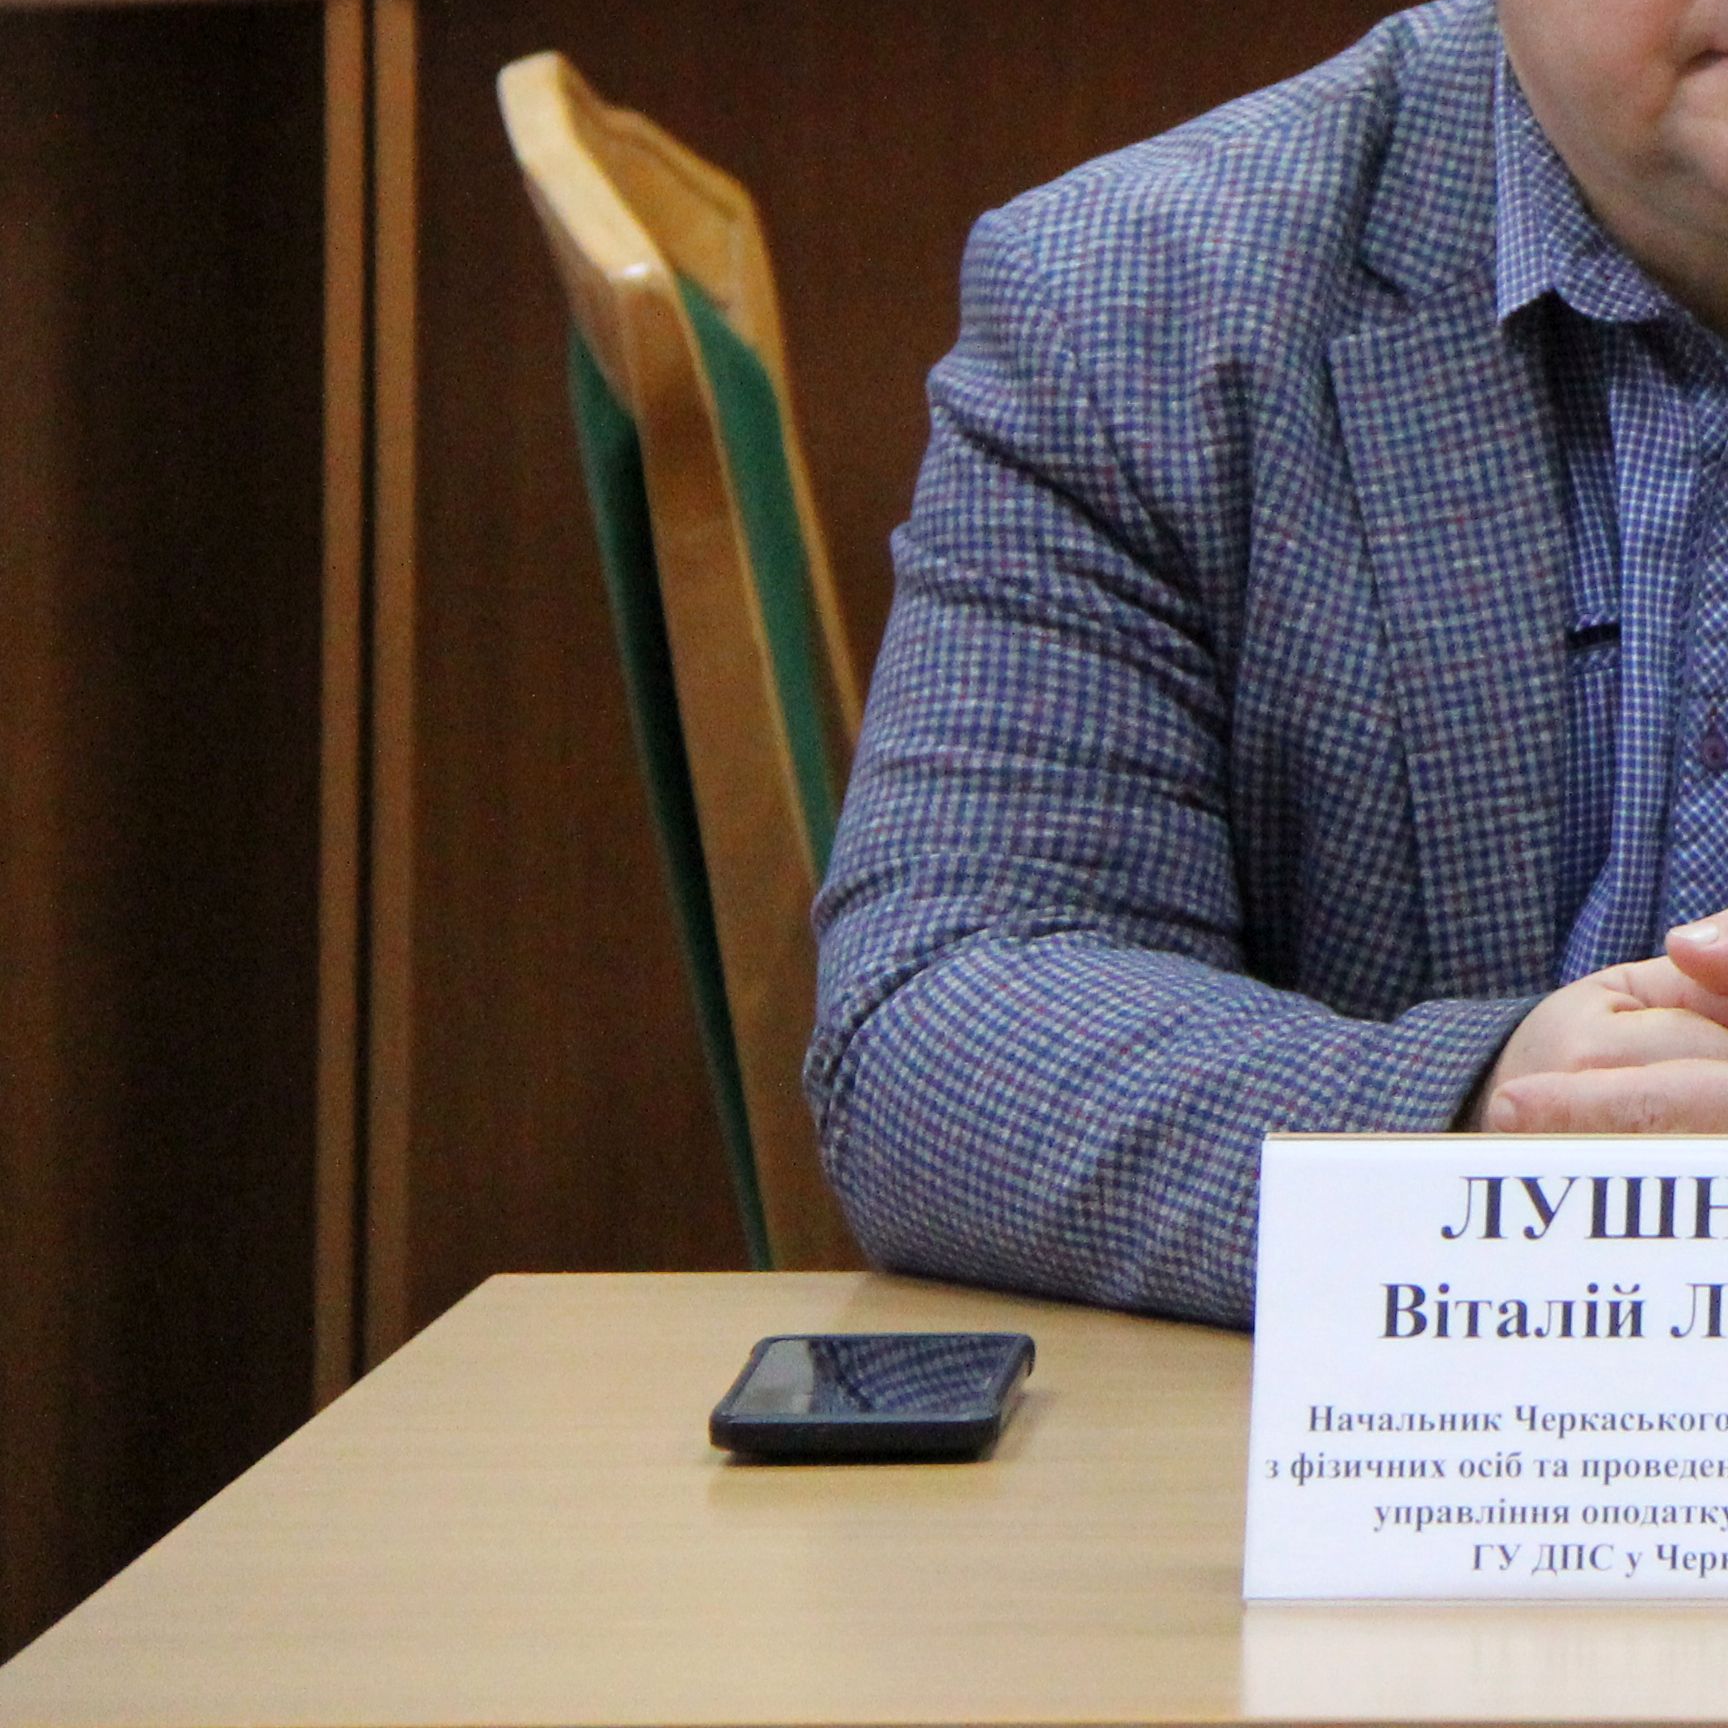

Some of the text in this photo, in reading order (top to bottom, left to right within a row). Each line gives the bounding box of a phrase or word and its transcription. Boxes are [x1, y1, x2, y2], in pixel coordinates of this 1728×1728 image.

[1379, 1281, 1646, 1340] Віталій
[1308, 1405, 1503, 1433] Начальник
[1265, 1459, 1280, 1479] з
[1289, 1451, 1446, 1487] фізичних
[1458, 1451, 1523, 1479] осіб
[1533, 1458, 1569, 1479] та
[1373, 1497, 1570, 1533] управління
[1472, 1543, 1521, 1571] ГУ
[1531, 1543, 1615, 1576] ДПС
[1624, 1551, 1643, 1579] у
